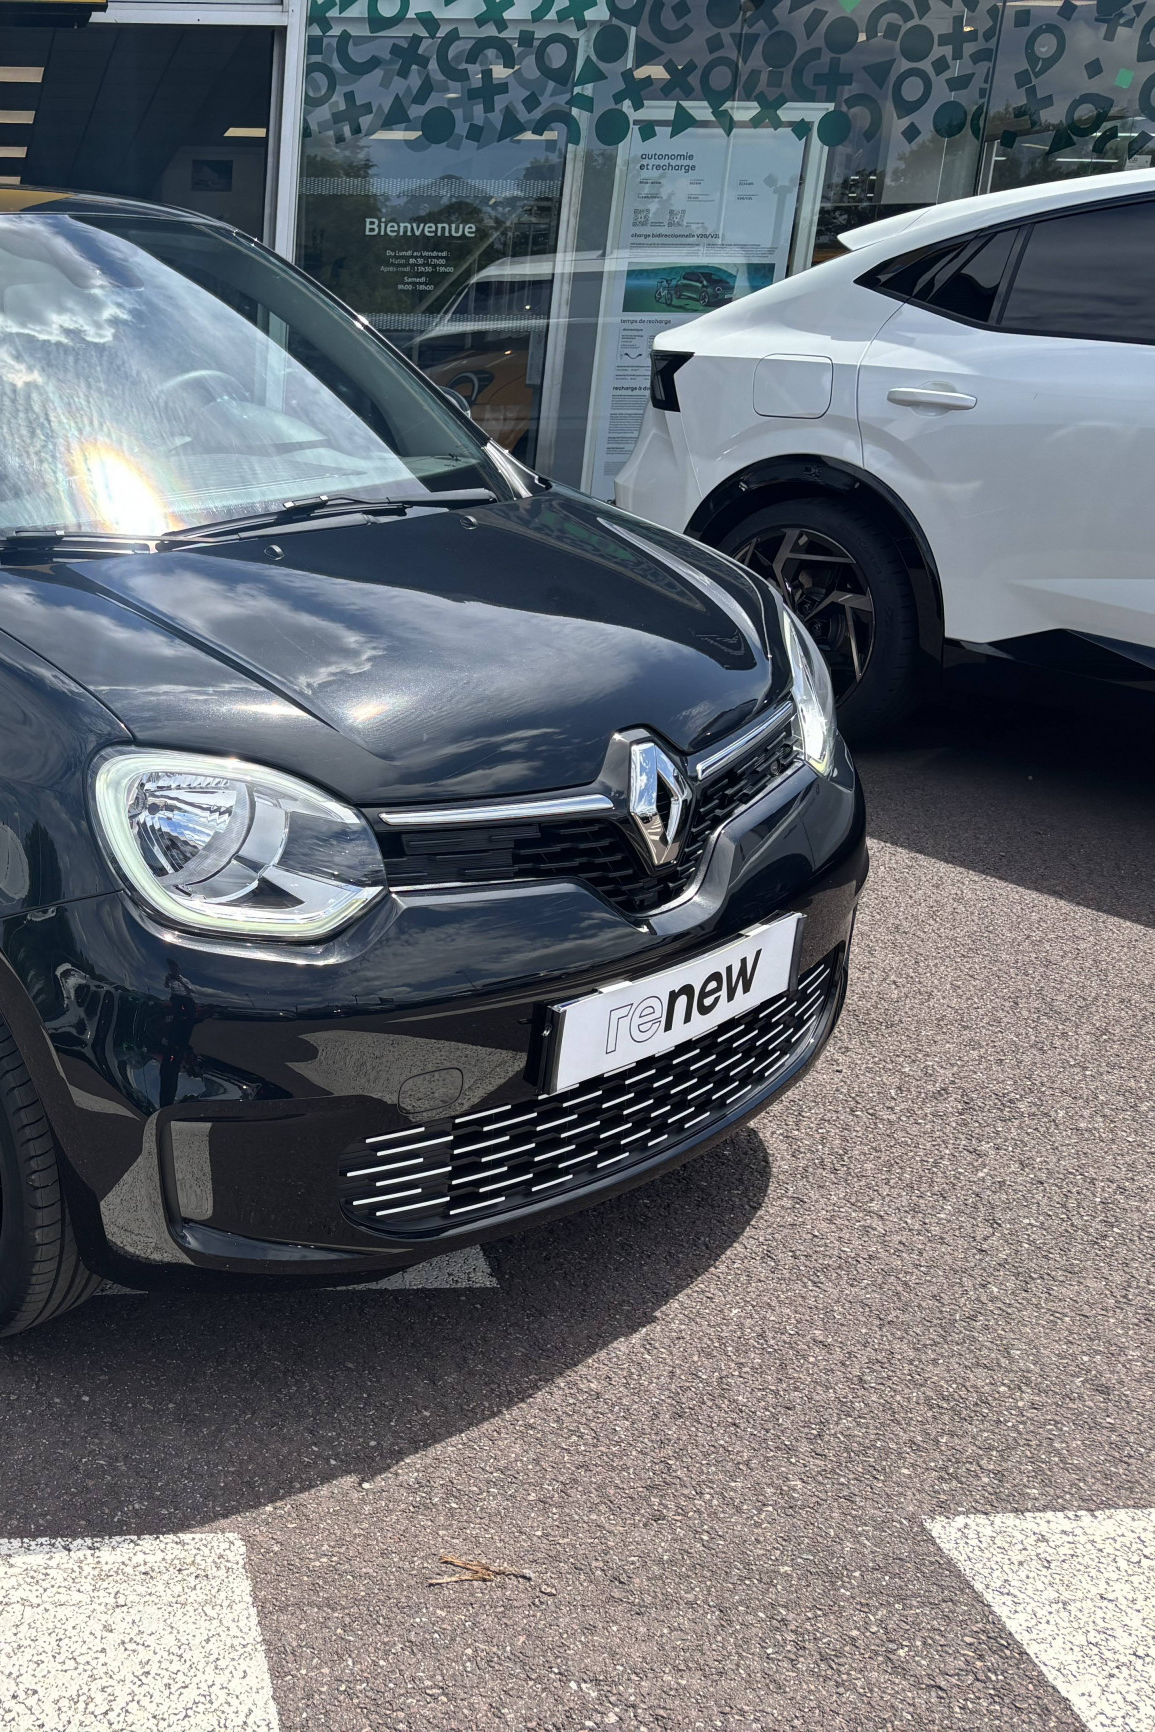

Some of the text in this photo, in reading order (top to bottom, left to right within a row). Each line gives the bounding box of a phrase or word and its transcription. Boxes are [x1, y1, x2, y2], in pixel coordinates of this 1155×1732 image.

[640, 152, 694, 161] autonomie
[639, 162, 696, 174] et recharge
[364, 217, 476, 237] Bienvenue
[605, 948, 763, 1055] renew
